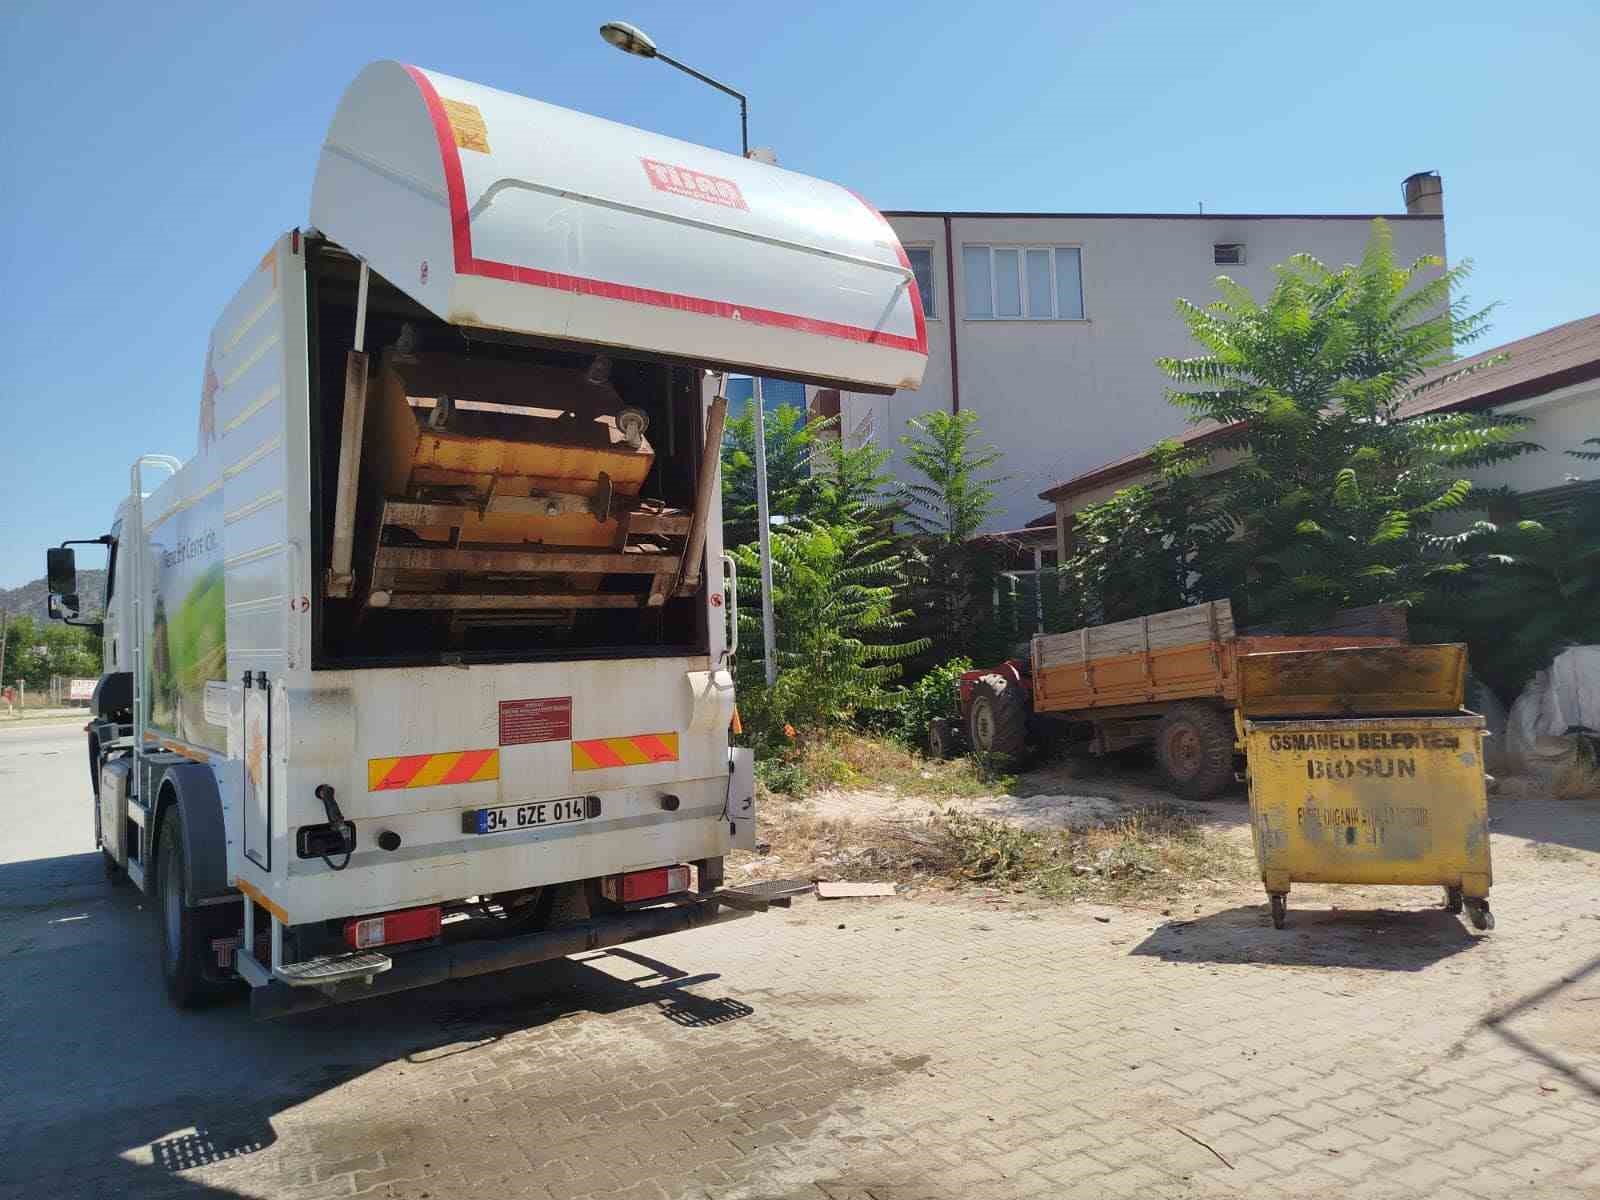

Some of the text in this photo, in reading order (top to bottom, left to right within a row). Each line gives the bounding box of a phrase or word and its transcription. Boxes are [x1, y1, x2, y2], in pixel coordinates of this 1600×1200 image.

[487, 810, 507, 830] 34
[517, 804, 546, 826] GZE
[554, 799, 582, 820] 014
